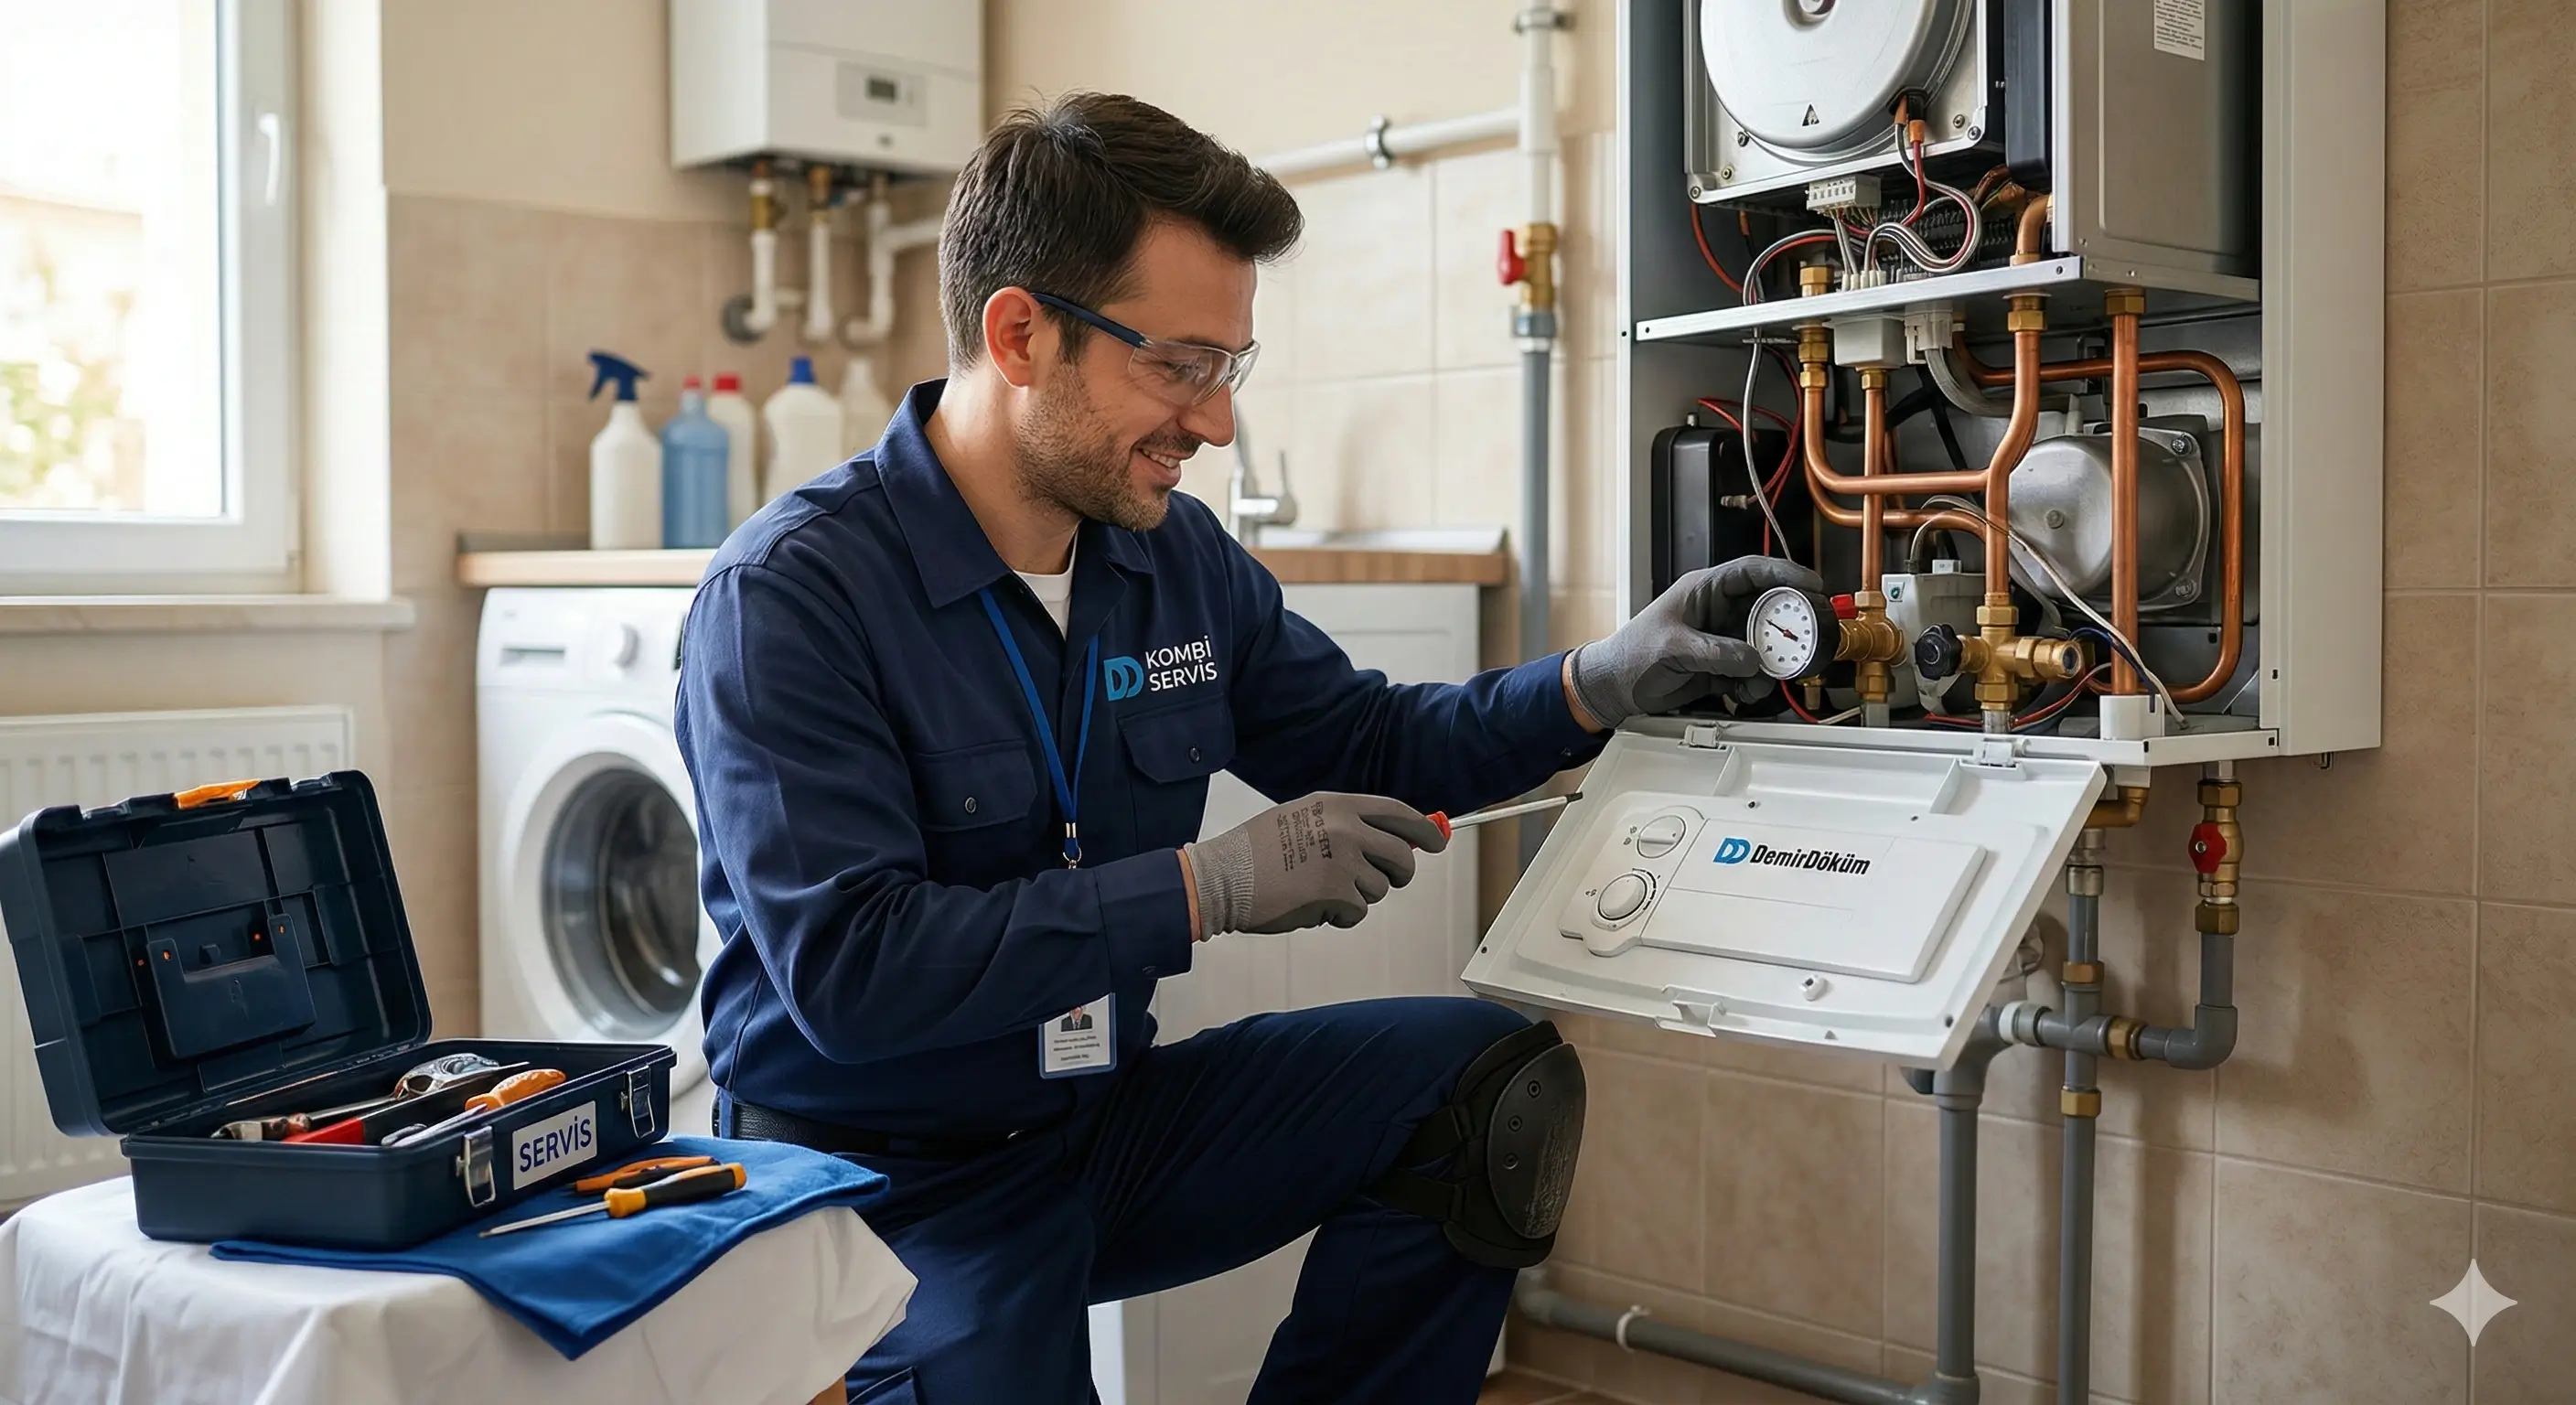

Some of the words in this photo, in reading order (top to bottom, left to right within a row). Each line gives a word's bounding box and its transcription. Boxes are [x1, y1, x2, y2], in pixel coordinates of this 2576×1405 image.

[1144, 635, 1212, 670] KOMBİ
[1149, 659, 1218, 692] SERVİS
[1749, 844, 1871, 875] DemirDöküm
[519, 1115, 592, 1173] SERVİS
